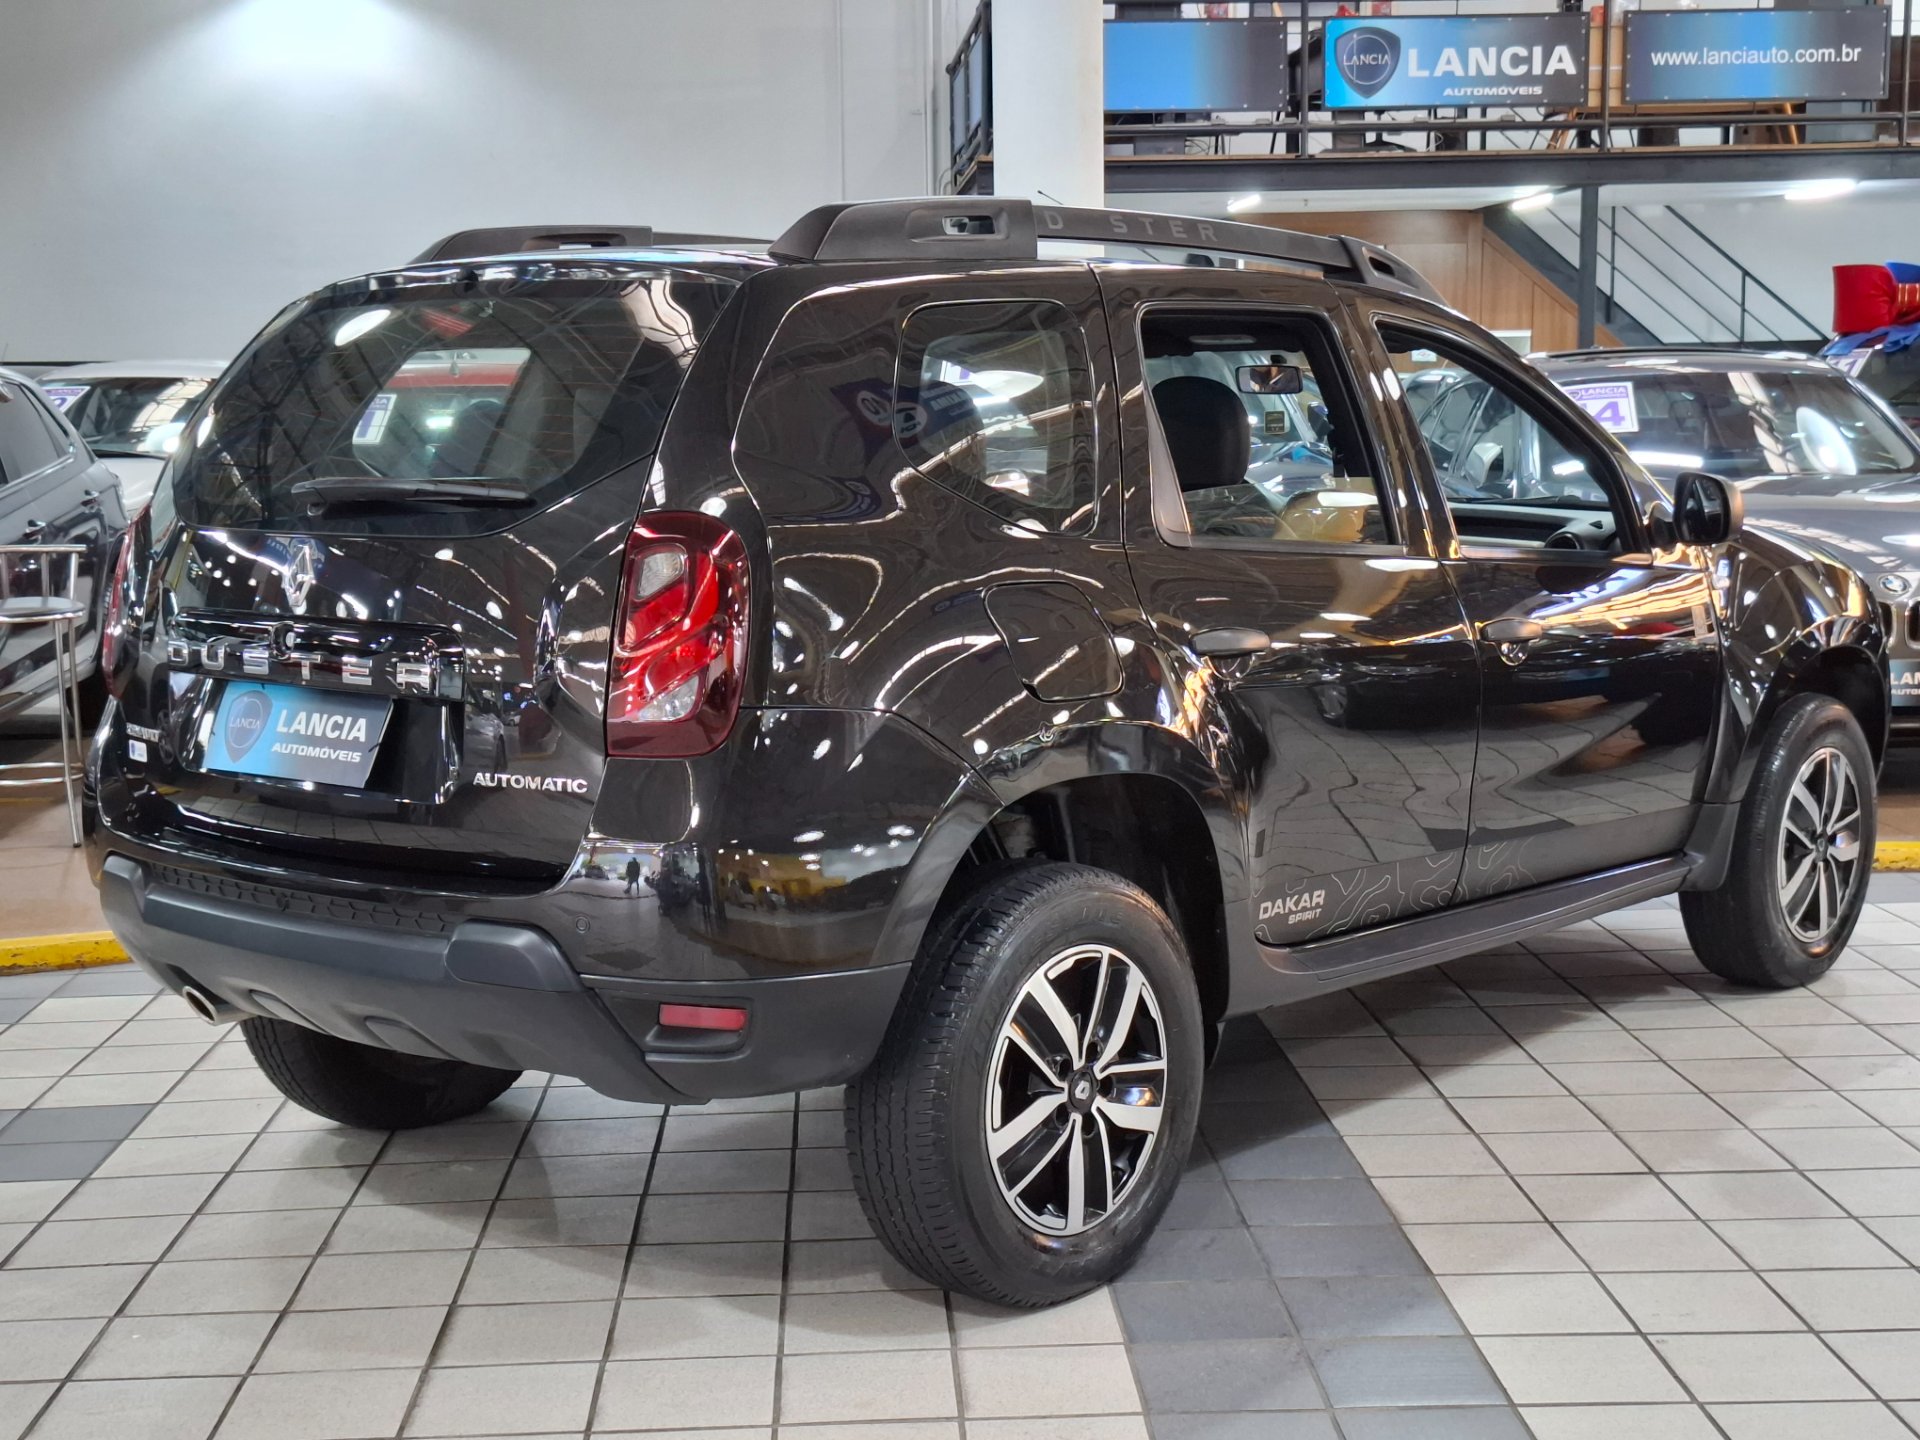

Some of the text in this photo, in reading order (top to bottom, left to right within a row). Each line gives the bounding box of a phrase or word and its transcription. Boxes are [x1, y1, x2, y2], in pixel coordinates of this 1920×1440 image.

[1343, 54, 1391, 66] LANCIA
[1407, 45, 1577, 78] LANCIA
[1650, 43, 1862, 66] www.lanciauto.com.br
[1442, 85, 1544, 97] AUTOMÓVEIS
[1581, 386, 1628, 396] LANCIA
[167, 641, 432, 692] DUSTER
[229, 716, 261, 729] LANCIA
[276, 710, 367, 742] LANCIA
[271, 741, 362, 762] AUTOMÓVEIS
[472, 772, 588, 794] AUTOMATIC
[1259, 889, 1326, 920] DAKAR
[1287, 908, 1322, 925] SPIRIT
